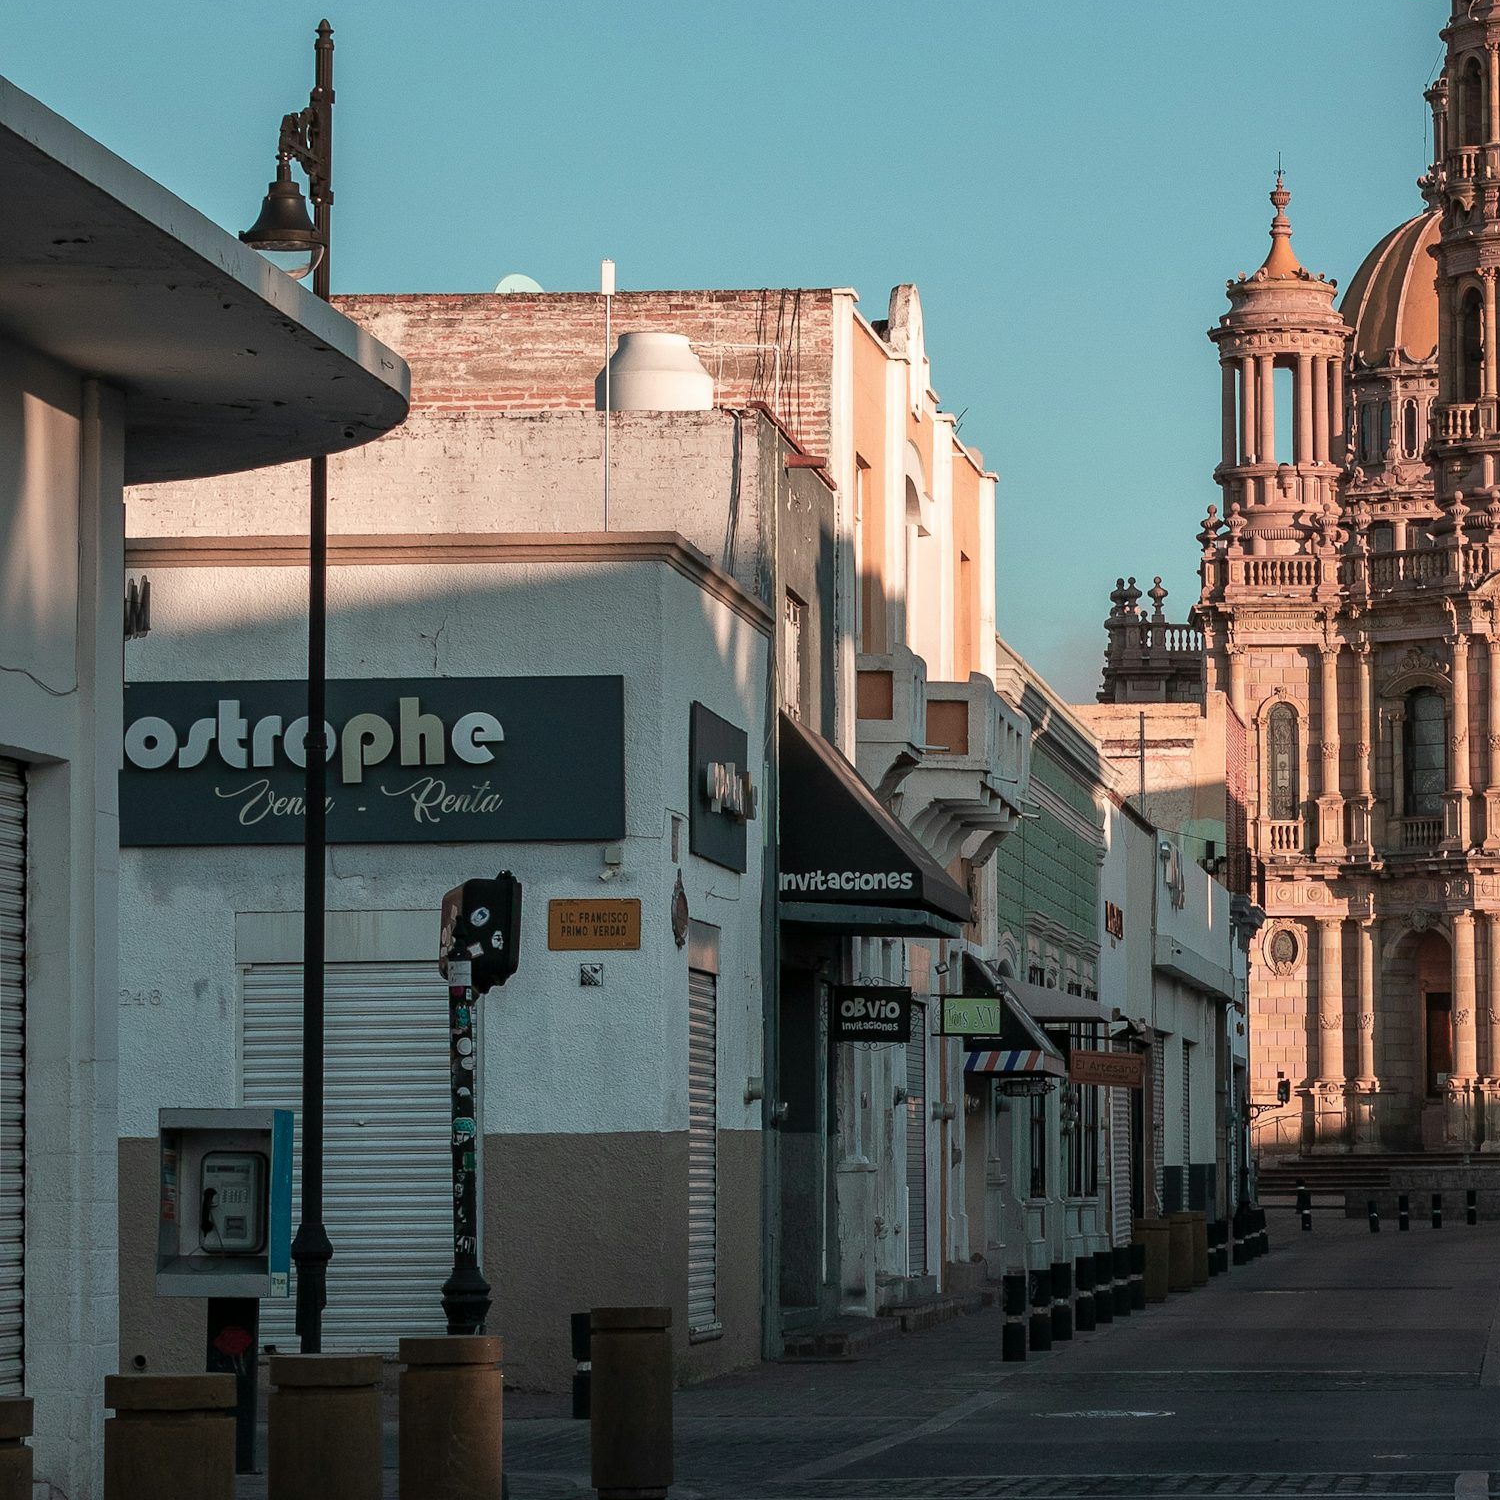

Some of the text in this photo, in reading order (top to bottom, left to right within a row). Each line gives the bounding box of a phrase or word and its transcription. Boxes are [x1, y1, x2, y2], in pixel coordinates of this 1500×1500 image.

[381, 777, 503, 823] Renta
[579, 912, 629, 924] FRANCISCO
[561, 925, 627, 937] PRIMO VERDAD
[1089, 1061, 1139, 1074] Artesano
